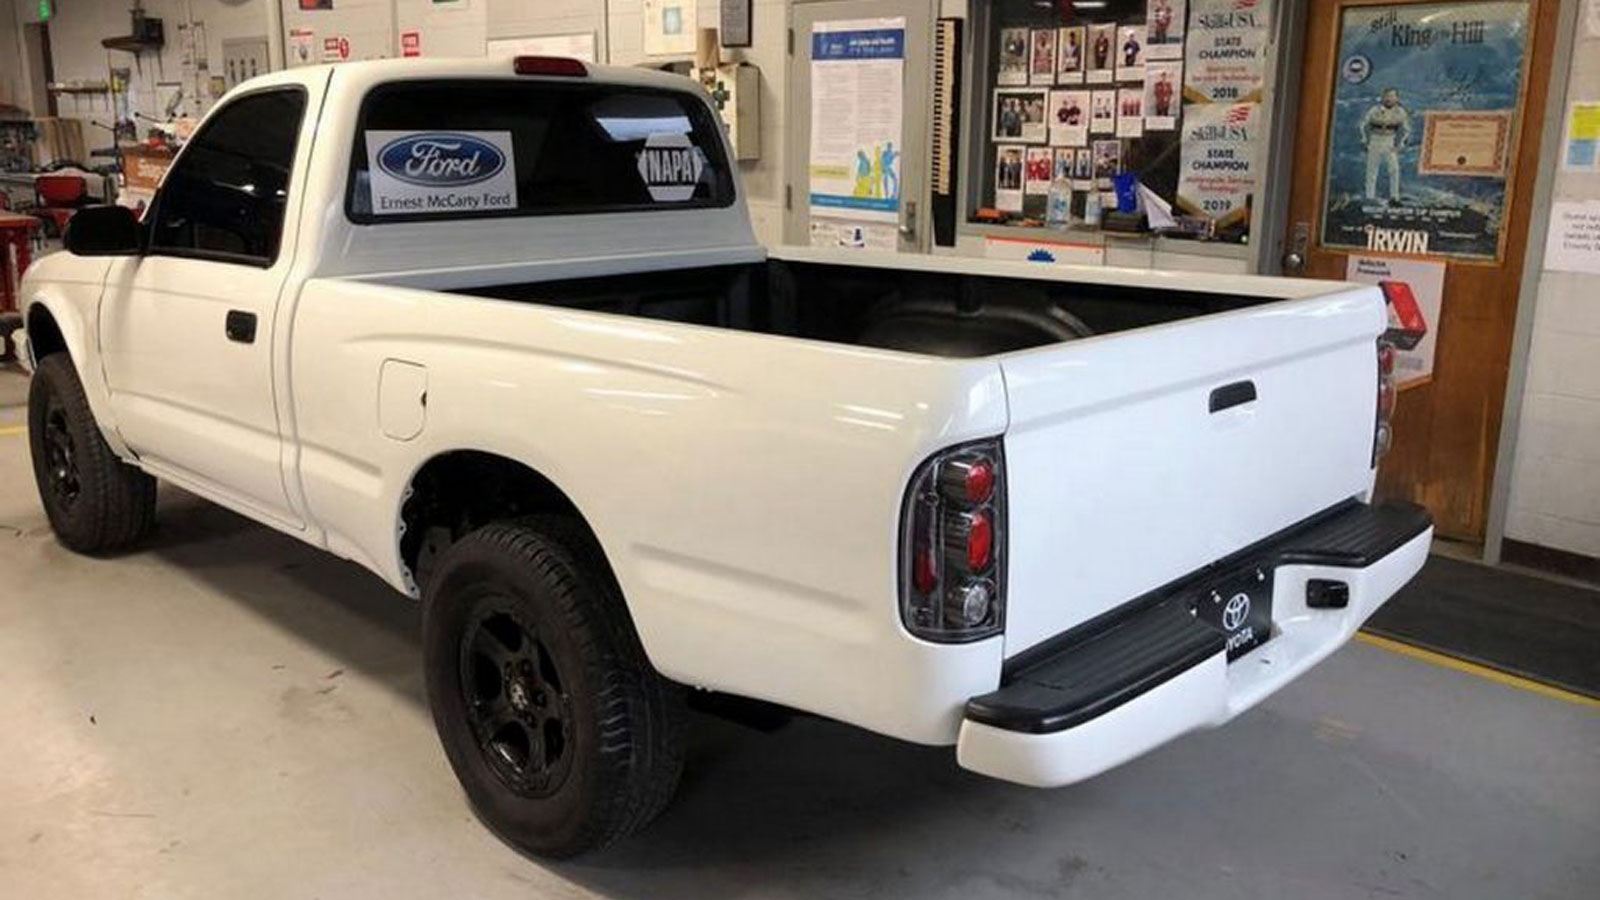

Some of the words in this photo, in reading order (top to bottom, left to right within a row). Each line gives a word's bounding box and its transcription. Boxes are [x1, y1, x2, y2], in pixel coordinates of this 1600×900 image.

[1214, 37, 1242, 46] STATE
[1391, 24, 1432, 51] King
[1451, 20, 1484, 44] Hill
[1199, 49, 1256, 59] CHAMPION
[1212, 86, 1239, 98] 2018
[1190, 126, 1249, 141] SkillsUSA
[405, 140, 481, 176] Ford
[1207, 149, 1234, 159] STATE
[647, 149, 693, 182] NAPA
[1192, 161, 1249, 171] CHAMPION
[380, 195, 423, 210] Ernest
[427, 193, 480, 208] McCarty
[483, 192, 511, 206] Ford
[1203, 200, 1232, 210] 2019
[1365, 226, 1429, 254] IRWIN
[1225, 626, 1254, 652] YOTA
